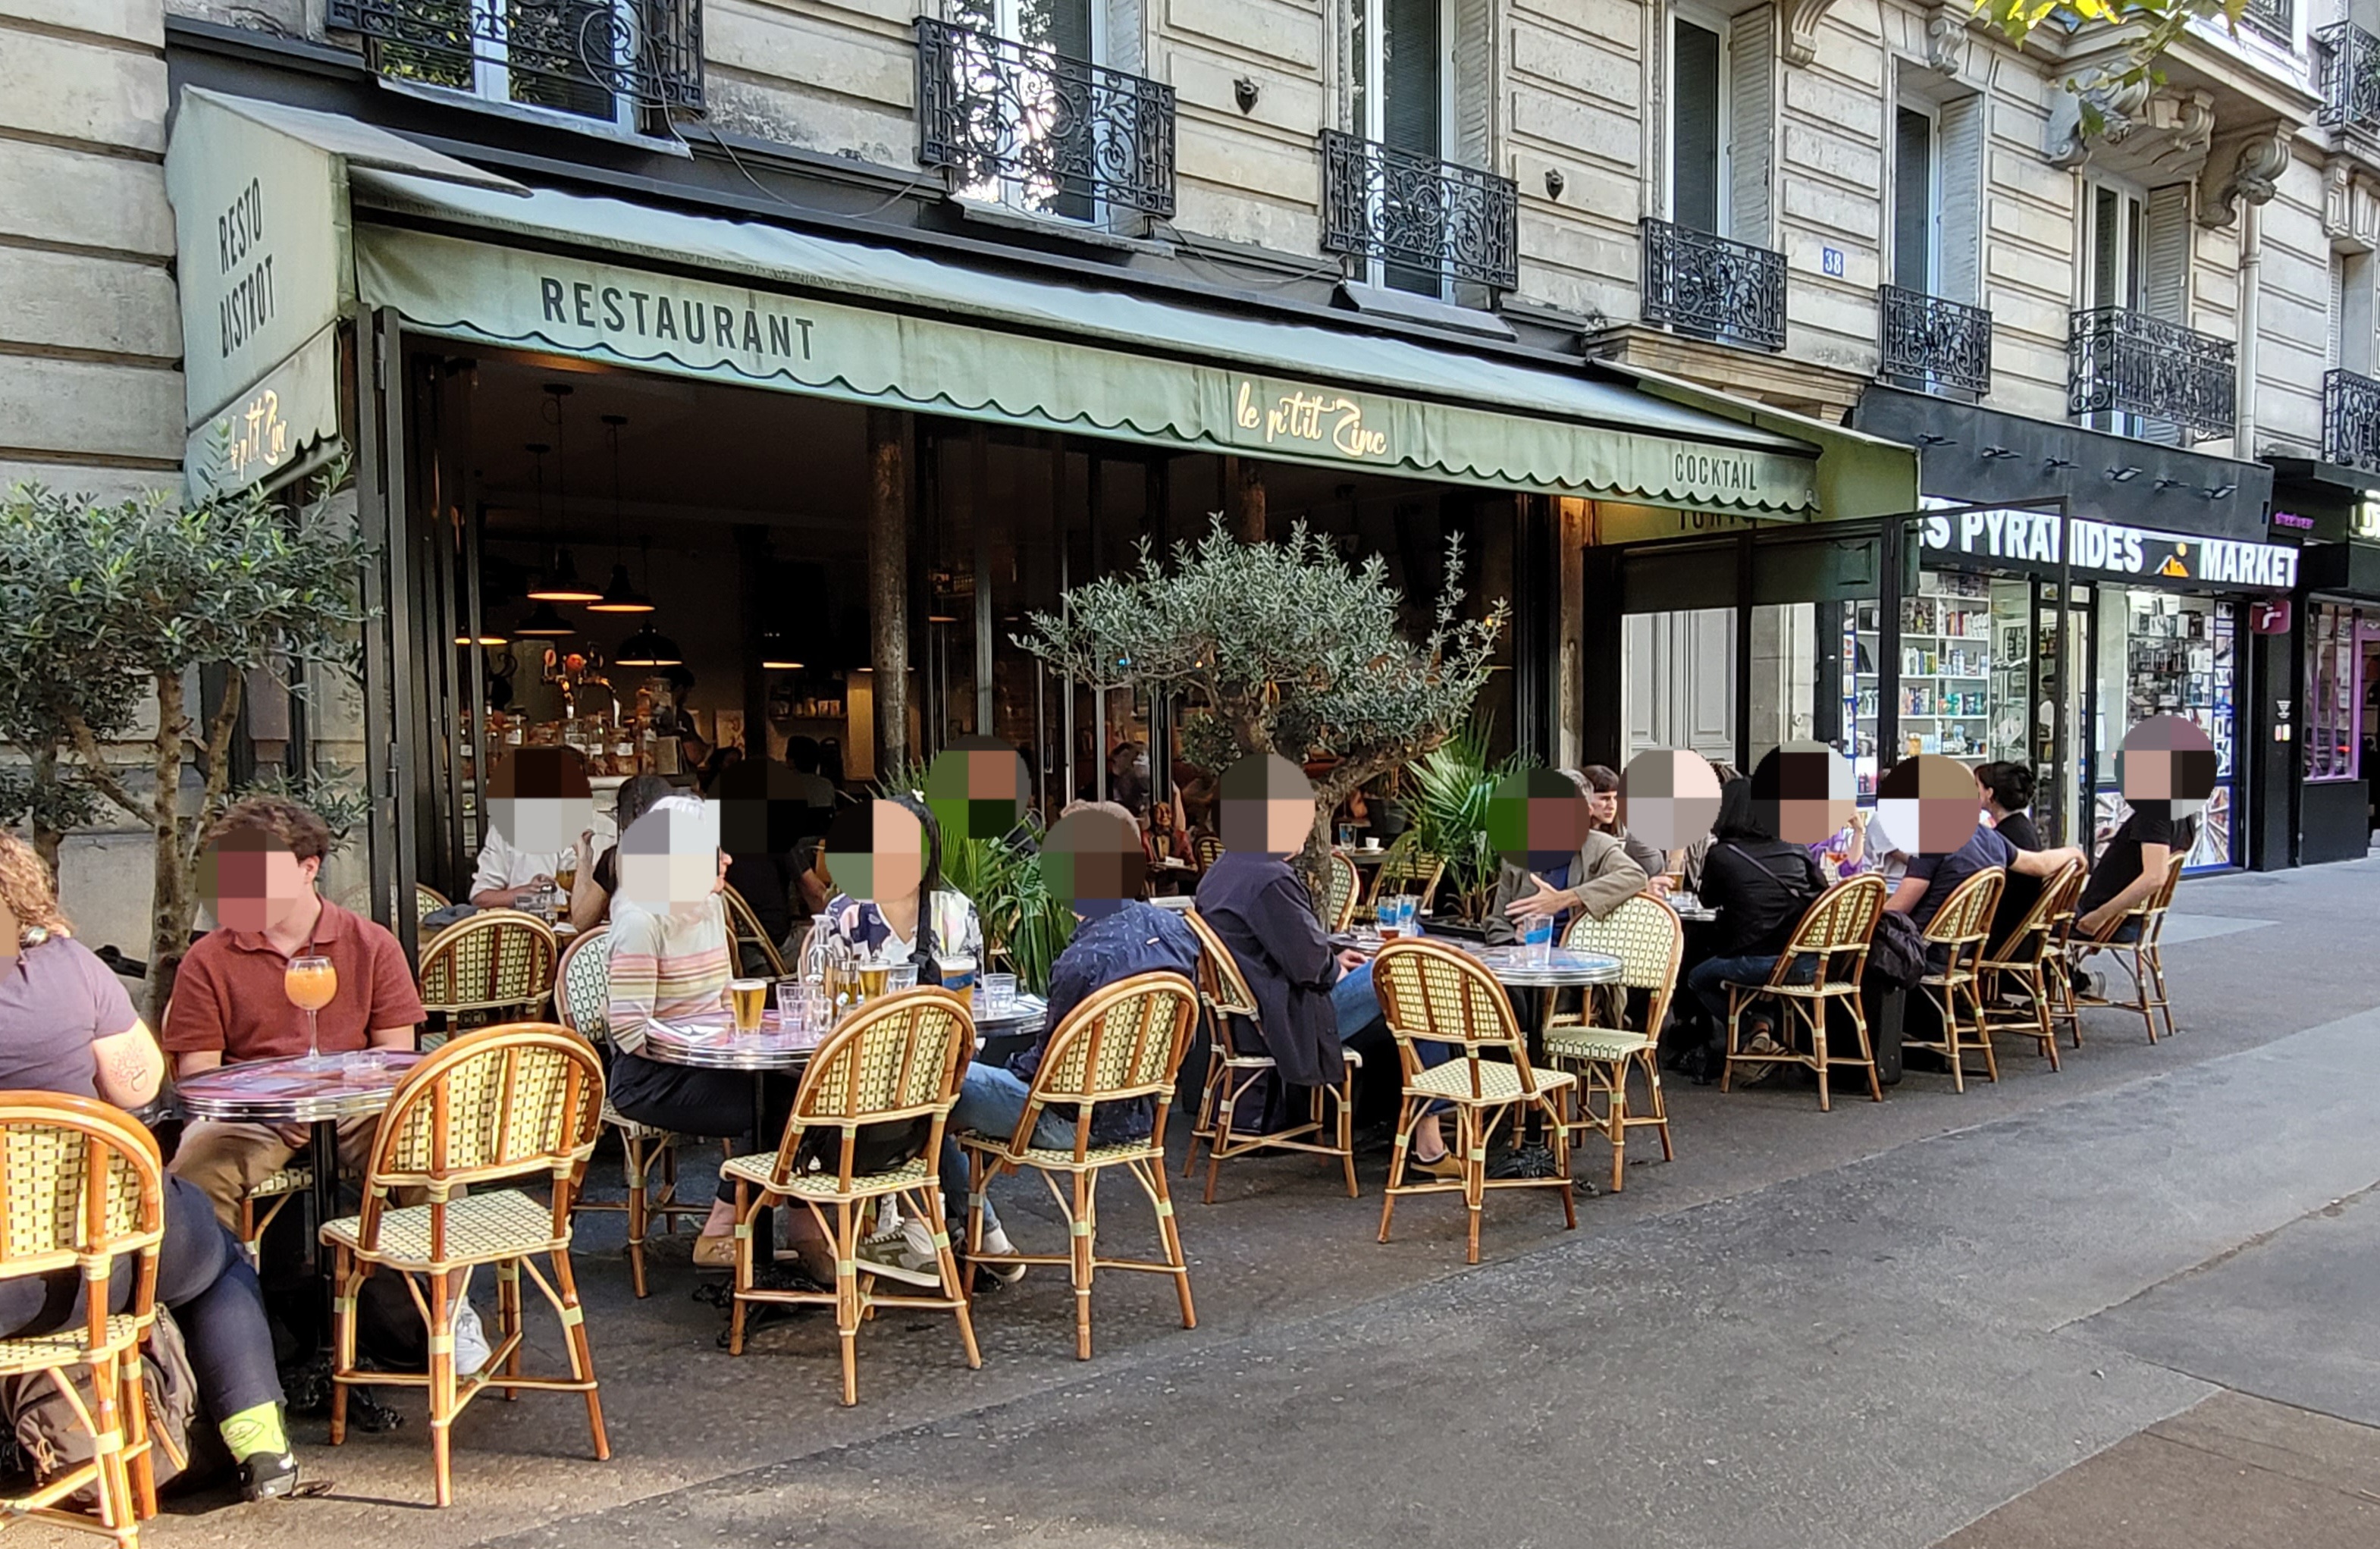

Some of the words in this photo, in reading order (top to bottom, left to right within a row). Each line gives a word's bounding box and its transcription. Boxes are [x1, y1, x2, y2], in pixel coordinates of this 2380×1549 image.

[218, 177, 262, 275] RESTO
[1825, 250, 1842, 274] 38
[220, 253, 274, 359] BISTROT
[541, 277, 814, 361] RESTAURANT
[1237, 381, 1260, 428] le
[1333, 398, 1388, 457] Zinc
[1675, 453, 1758, 491] COCKTAIL
[2200, 540, 2298, 588] MARKET
